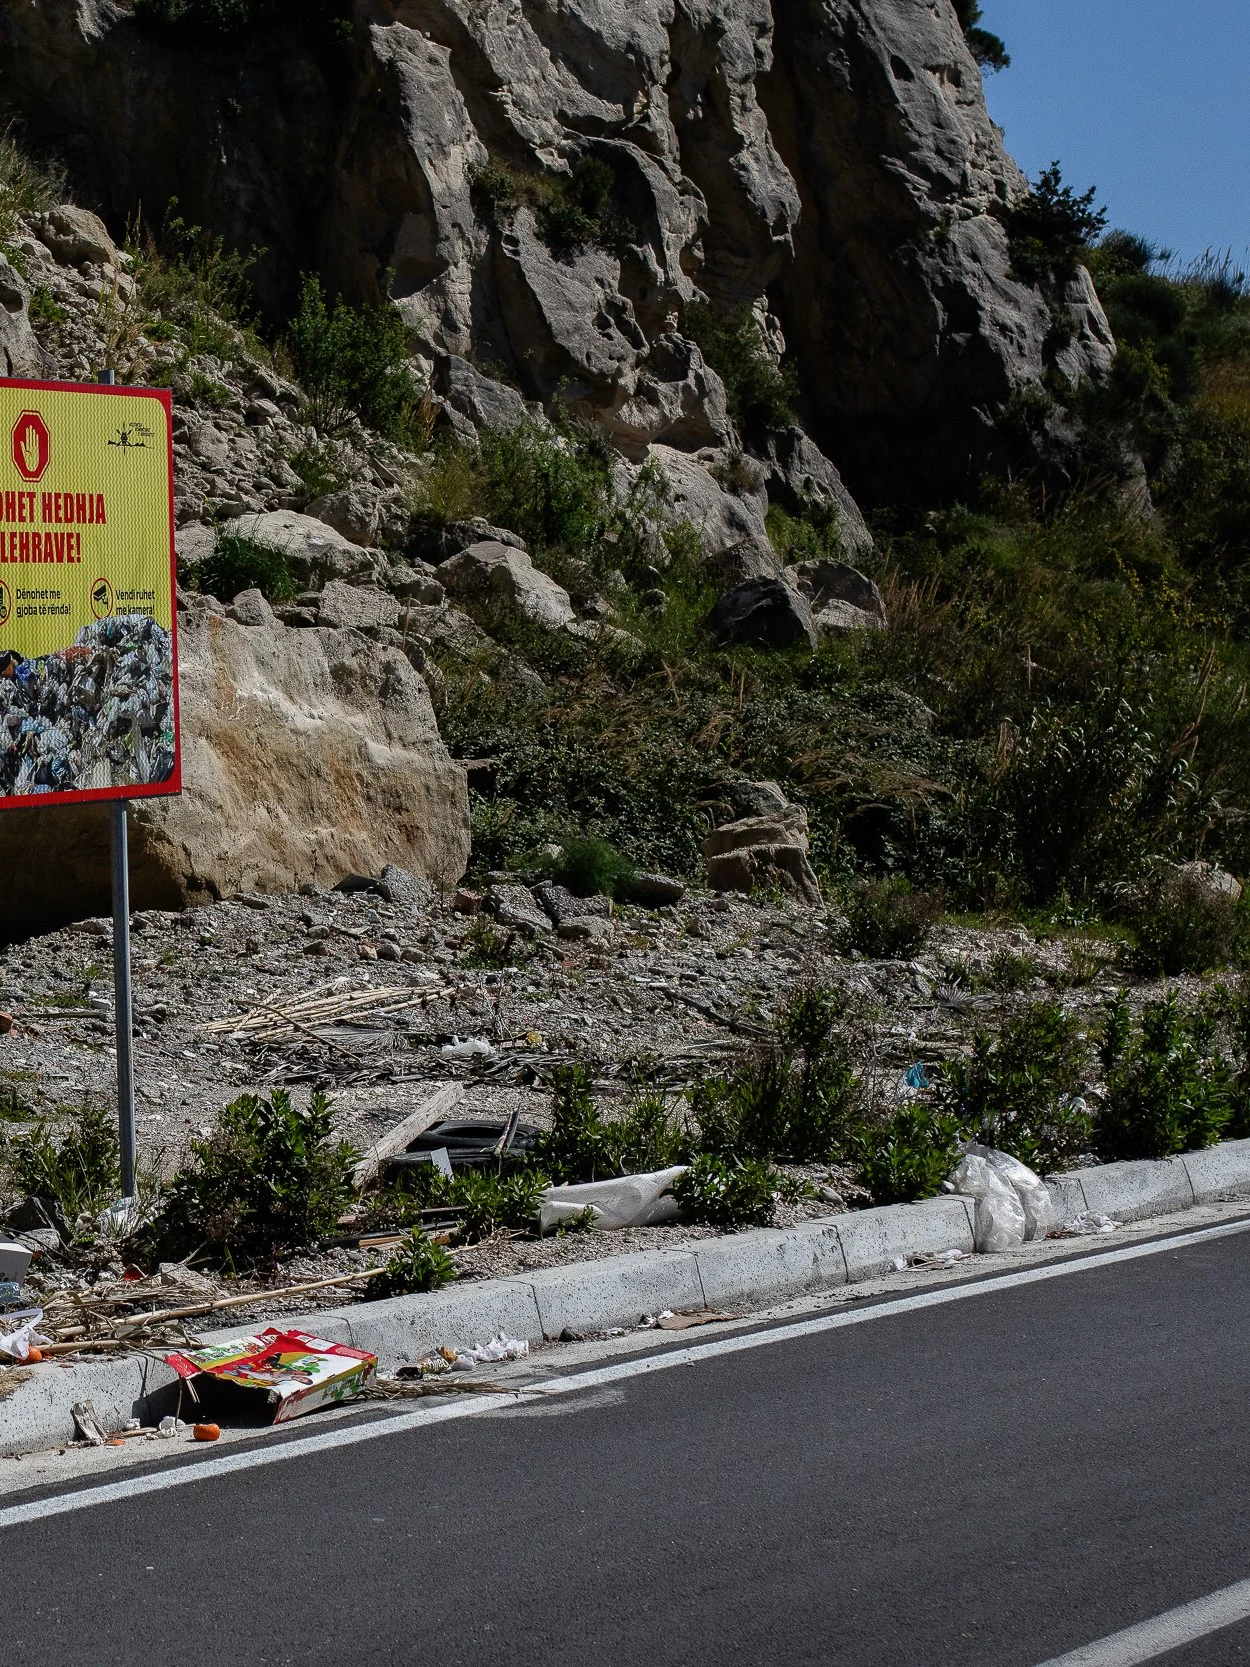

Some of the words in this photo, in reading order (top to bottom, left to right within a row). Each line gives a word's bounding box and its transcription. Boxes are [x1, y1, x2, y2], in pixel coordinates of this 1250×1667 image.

[41, 492, 106, 524] HEDHJA
[16, 588, 48, 599] Dënohet
[50, 590, 60, 599] me
[115, 589, 135, 600] Vendi
[136, 589, 155, 600] ruhet
[16, 604, 37, 618] gjoba
[39, 604, 47, 615] të
[48, 603, 71, 615] rënda!
[116, 606, 127, 615] me
[127, 604, 155, 615] kamera!
